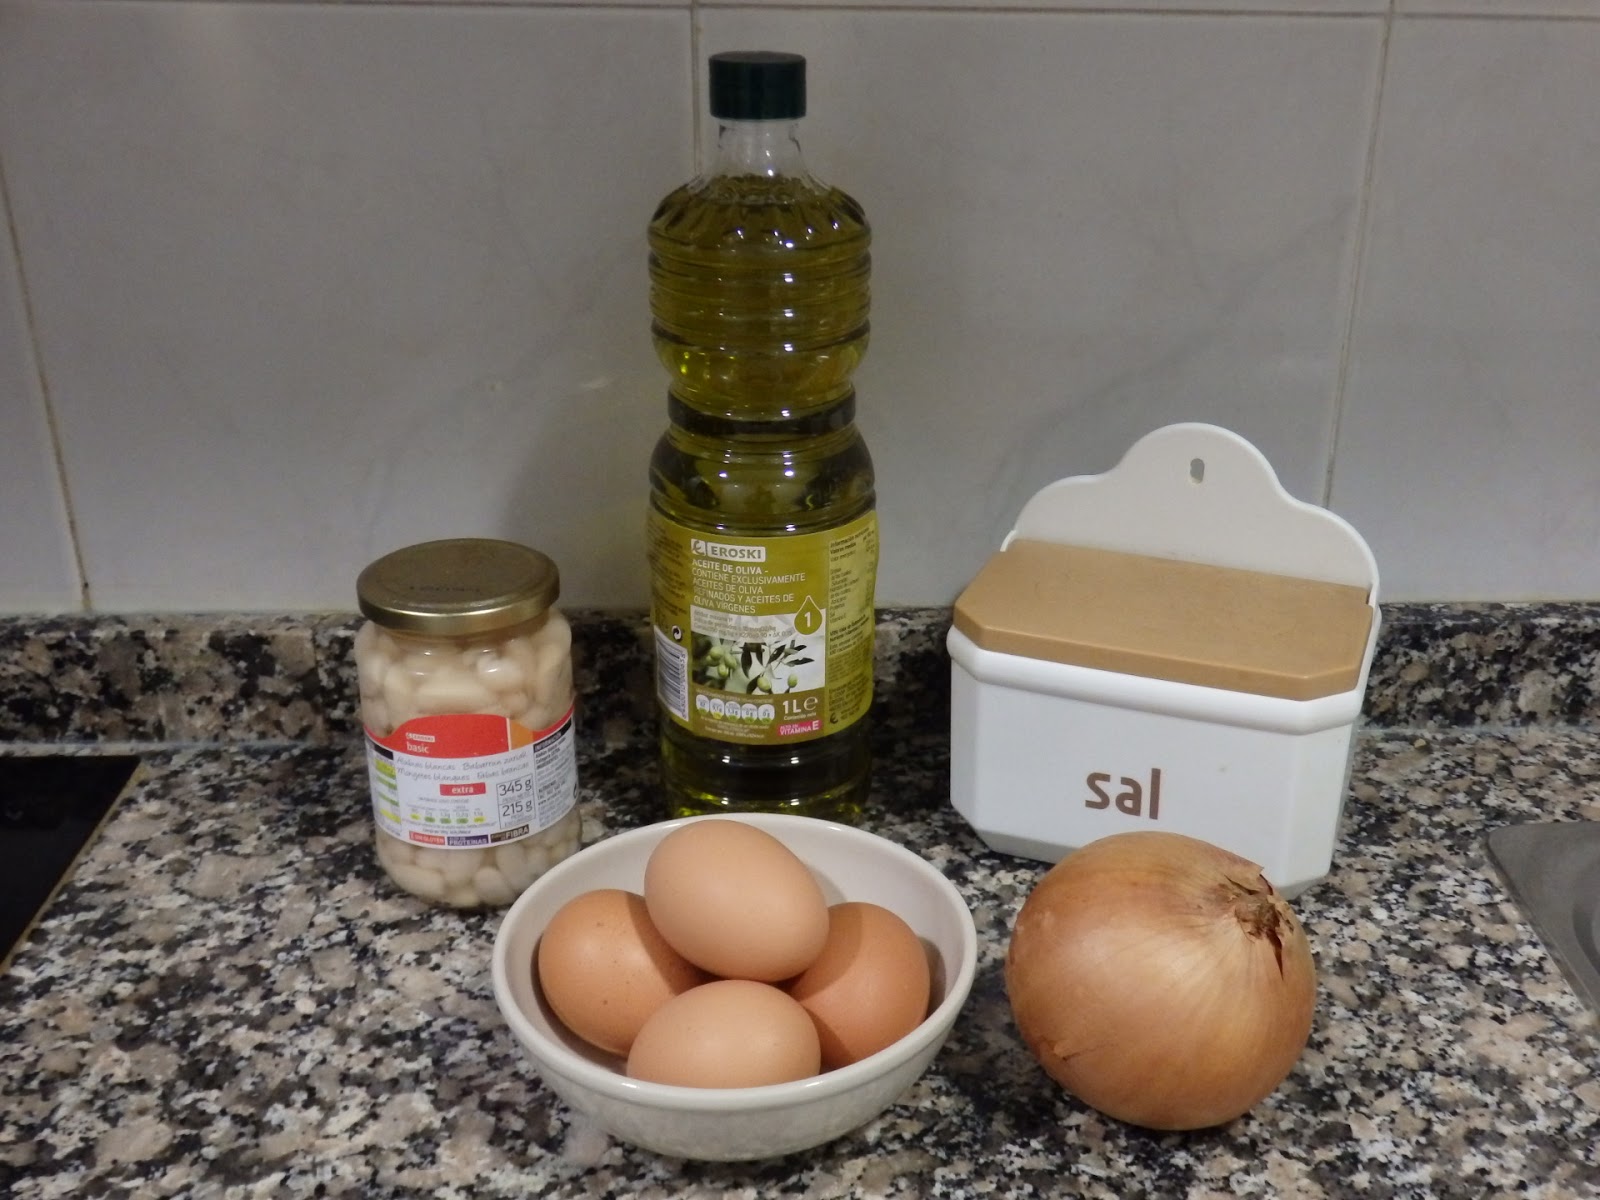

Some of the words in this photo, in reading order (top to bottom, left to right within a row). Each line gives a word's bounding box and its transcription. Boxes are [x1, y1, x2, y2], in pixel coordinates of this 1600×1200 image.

[711, 545, 762, 559] EROSKI
[692, 559, 720, 571] ACEITE
[722, 563, 733, 573] DE
[735, 566, 762, 575] OLIVA
[692, 567, 729, 582] CONTIENE
[731, 573, 806, 585] EXCLUSIVAMENTE
[692, 577, 723, 591] ACEITES
[725, 584, 736, 593] DE
[738, 586, 764, 595] OLIVA
[693, 586, 735, 602] REFINADOS
[745, 595, 780, 604] ACEITES
[782, 593, 795, 602] DE
[693, 595, 714, 608] OLIVA
[804, 611, 811, 627] 1
[780, 726, 812, 735] VITAMINA
[812, 720, 820, 731] E
[406, 741, 429, 753] basic
[451, 786, 474, 794] extra
[498, 780, 523, 796] 345
[525, 779, 532, 792] g
[1084, 767, 1161, 820] sal
[502, 801, 523, 817] 215
[525, 800, 533, 812] g
[505, 826, 529, 839] FIBRA
